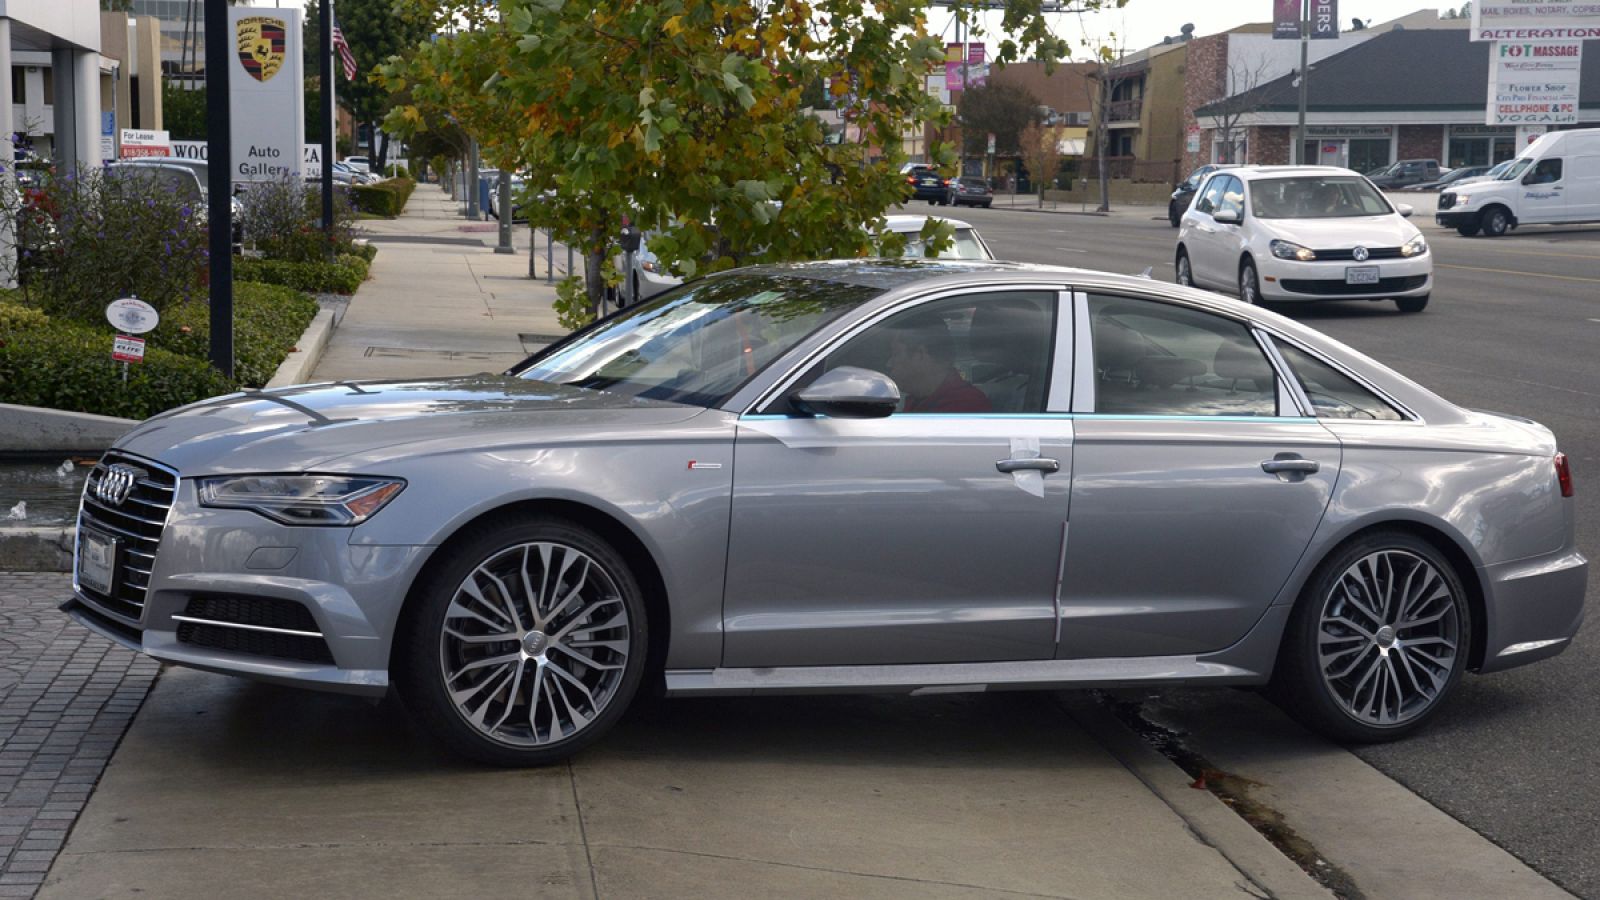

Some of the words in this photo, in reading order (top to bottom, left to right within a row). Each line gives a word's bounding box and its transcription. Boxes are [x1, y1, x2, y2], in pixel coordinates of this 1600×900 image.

[236, 16, 286, 27] PORSCHE
[1533, 45, 1579, 57] MASSAGE
[1499, 104, 1550, 113] CELLPHONE
[1552, 104, 1560, 113] &
[1561, 104, 1573, 113] PC
[1497, 115, 1552, 123] YOGA
[123, 131, 134, 139] For
[136, 132, 155, 141] Lease
[248, 145, 281, 158] Auto
[239, 162, 289, 177] Gallery
